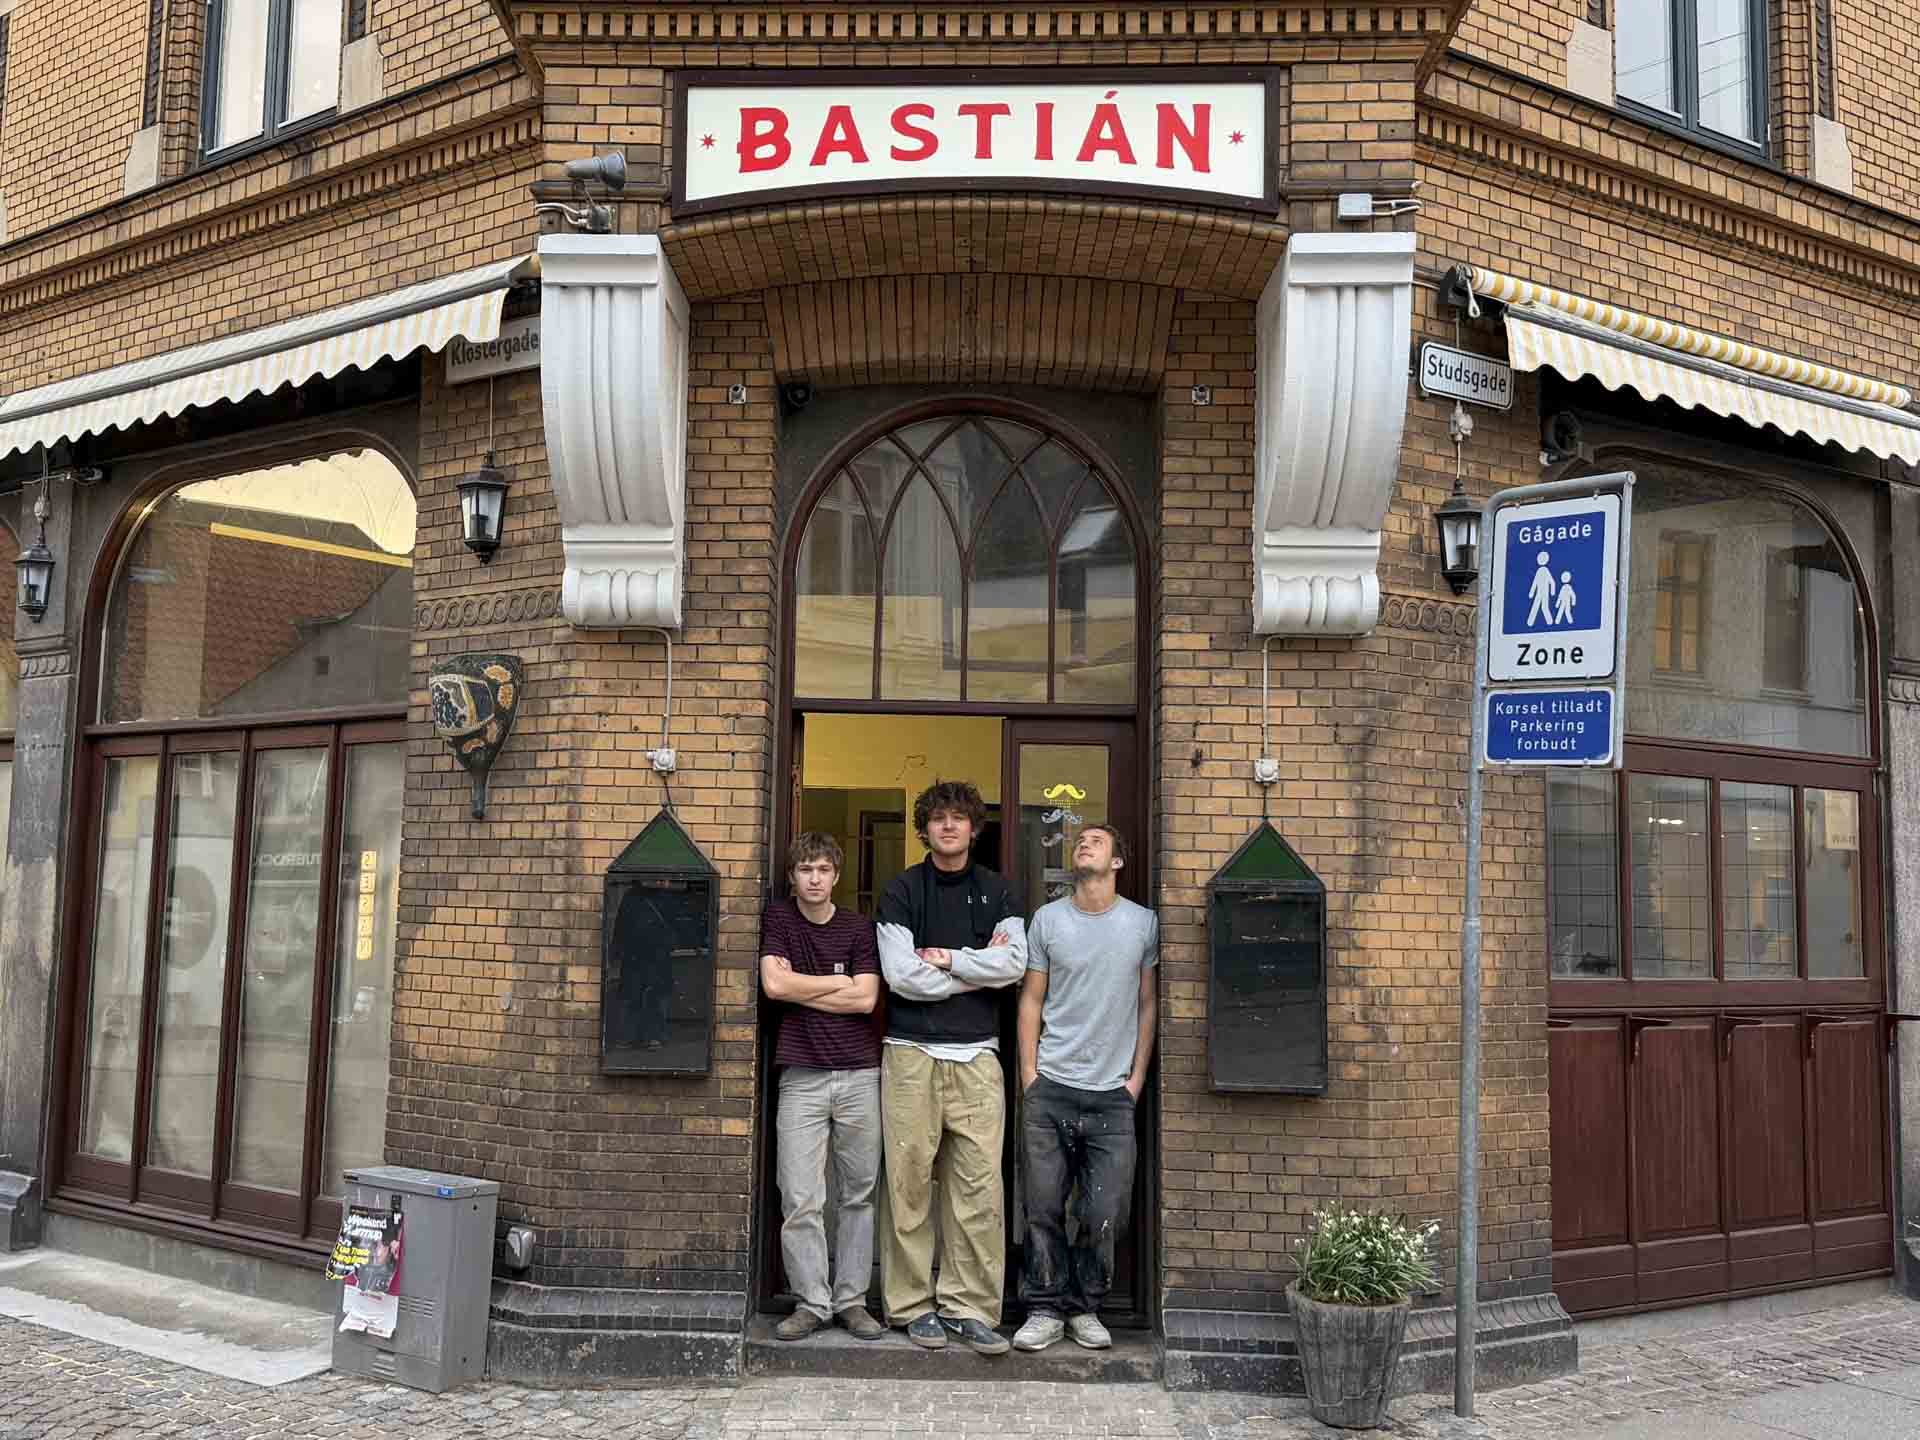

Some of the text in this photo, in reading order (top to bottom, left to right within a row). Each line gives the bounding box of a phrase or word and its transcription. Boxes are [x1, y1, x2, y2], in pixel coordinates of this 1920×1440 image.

[736, 90, 1211, 174] BASTIÁN
[450, 327, 540, 368] Klostergade
[1427, 353, 1507, 393] Studsgade
[1518, 522, 1593, 545] Gågade
[1516, 643, 1584, 666] Zone
[1495, 699, 1603, 715] Kørsel tilladt
[1510, 719, 1585, 733] Parkering
[1517, 737, 1577, 750] forbudt
